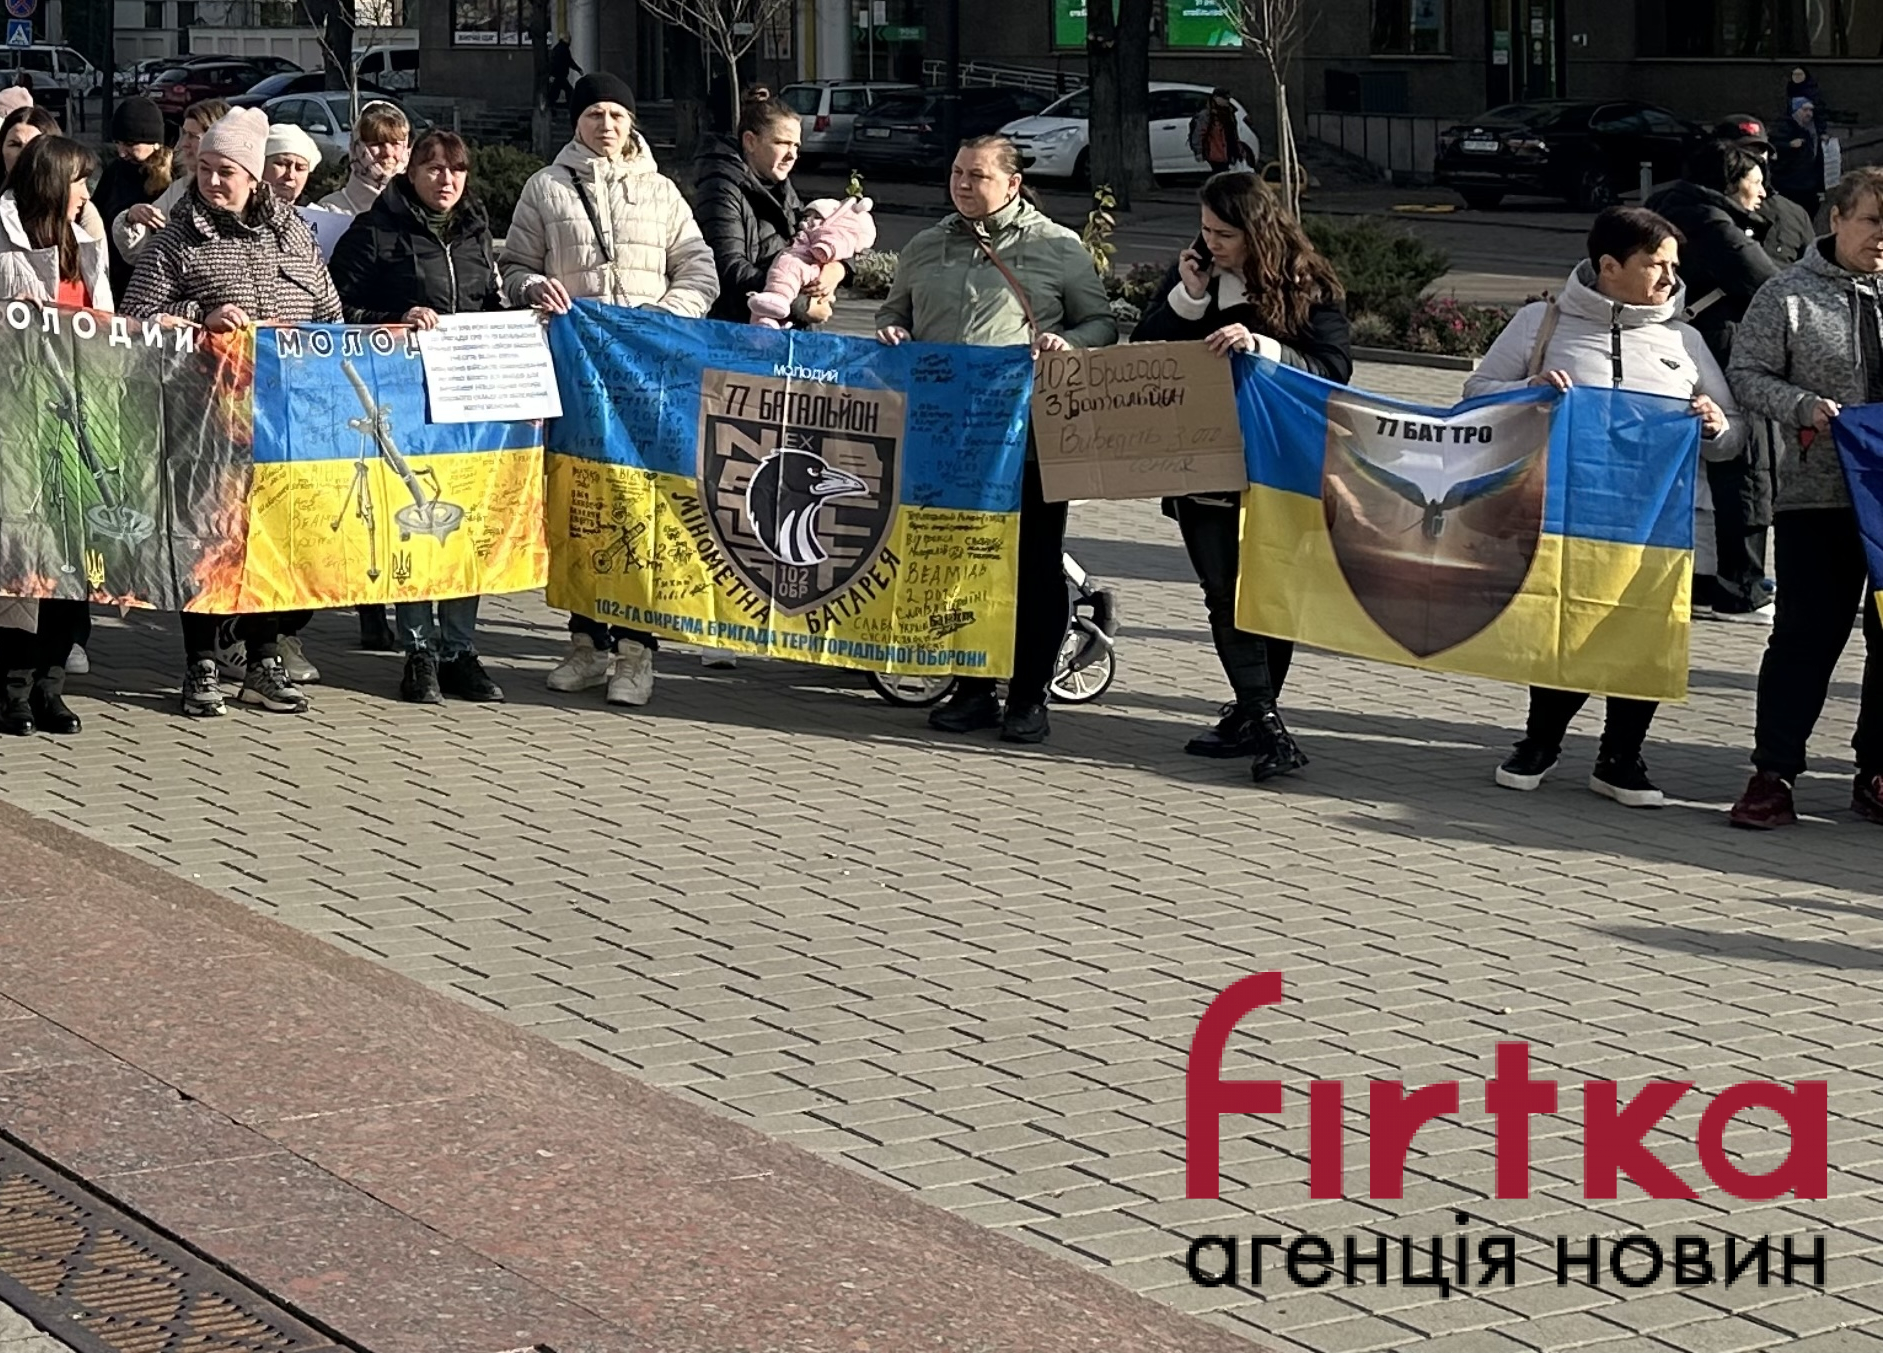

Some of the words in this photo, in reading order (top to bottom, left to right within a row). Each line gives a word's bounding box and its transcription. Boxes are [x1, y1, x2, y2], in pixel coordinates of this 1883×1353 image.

[773, 363, 839, 382] МОЛОДИЙ
[1033, 357, 1086, 395] 102
[1089, 354, 1186, 394] Бригада
[726, 384, 751, 417] 77
[759, 388, 880, 434] БАТАЛЬЙОН
[1376, 415, 1399, 437] 77
[1403, 420, 1447, 443] БАТ
[1450, 425, 1493, 444] ТРО
[671, 492, 772, 625] МІНОМЕТНА
[804, 546, 902, 635] БАТАРЕЯ
[779, 565, 810, 585] 102
[778, 583, 809, 599] ОБР
[595, 598, 643, 625] 102-ГА
[644, 610, 704, 635] ОКРЕМА
[707, 621, 777, 648] БРИГАДА
[916, 646, 988, 668] ОБОРОНИ
